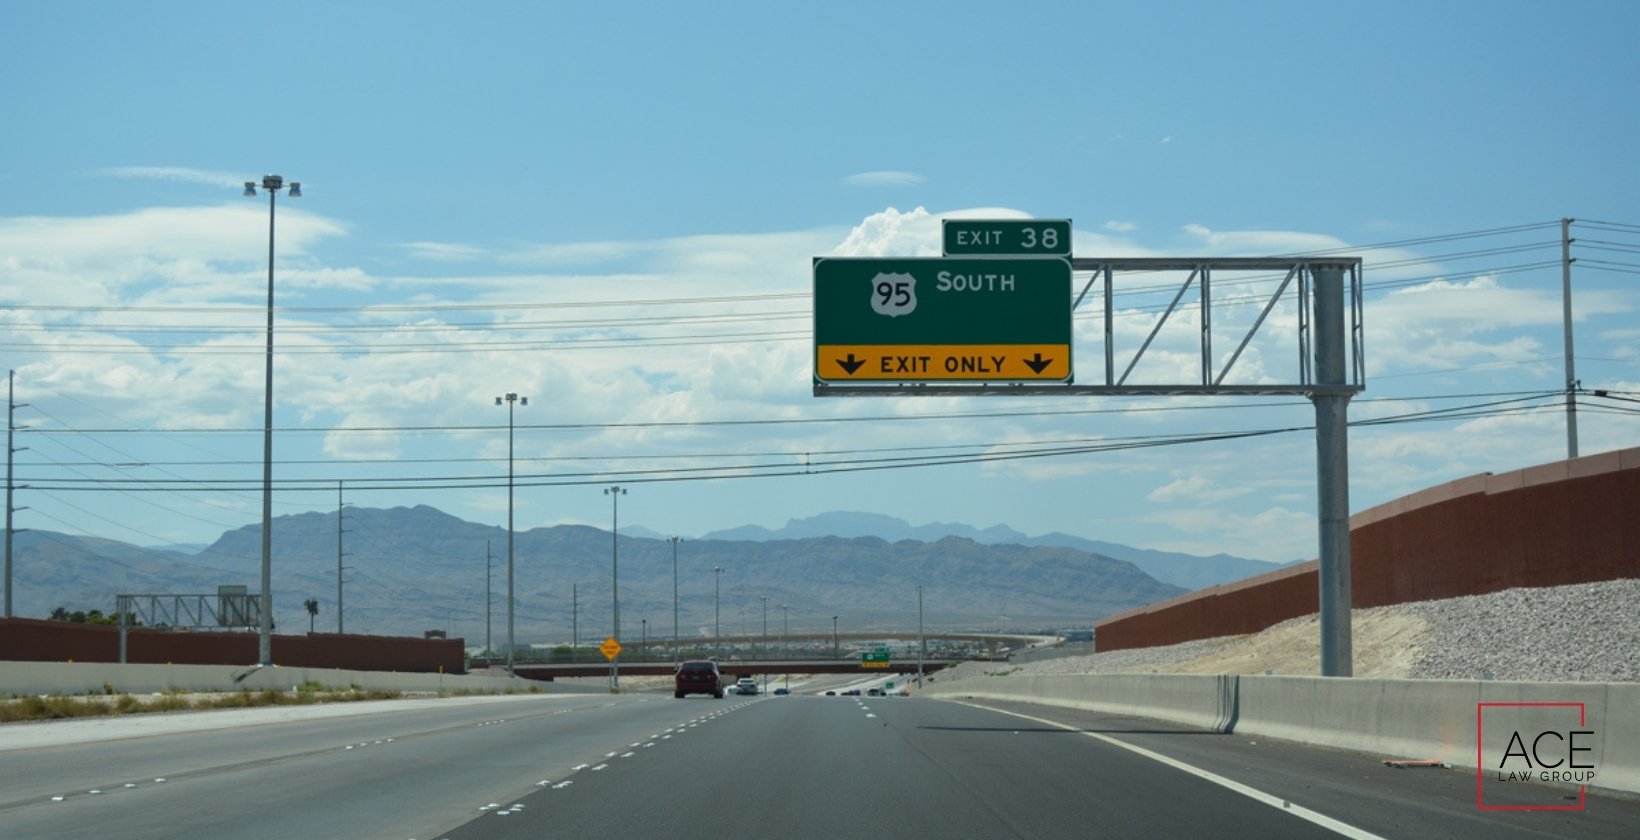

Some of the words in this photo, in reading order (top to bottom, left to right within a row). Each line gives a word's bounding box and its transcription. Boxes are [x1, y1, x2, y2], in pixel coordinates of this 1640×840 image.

[957, 231, 1003, 245] EXIT
[1021, 228, 1058, 248] 38
[876, 282, 910, 307] 95
[936, 271, 1015, 292] SOUTH
[881, 356, 930, 373] EXIT
[945, 356, 1006, 373] ONLY
